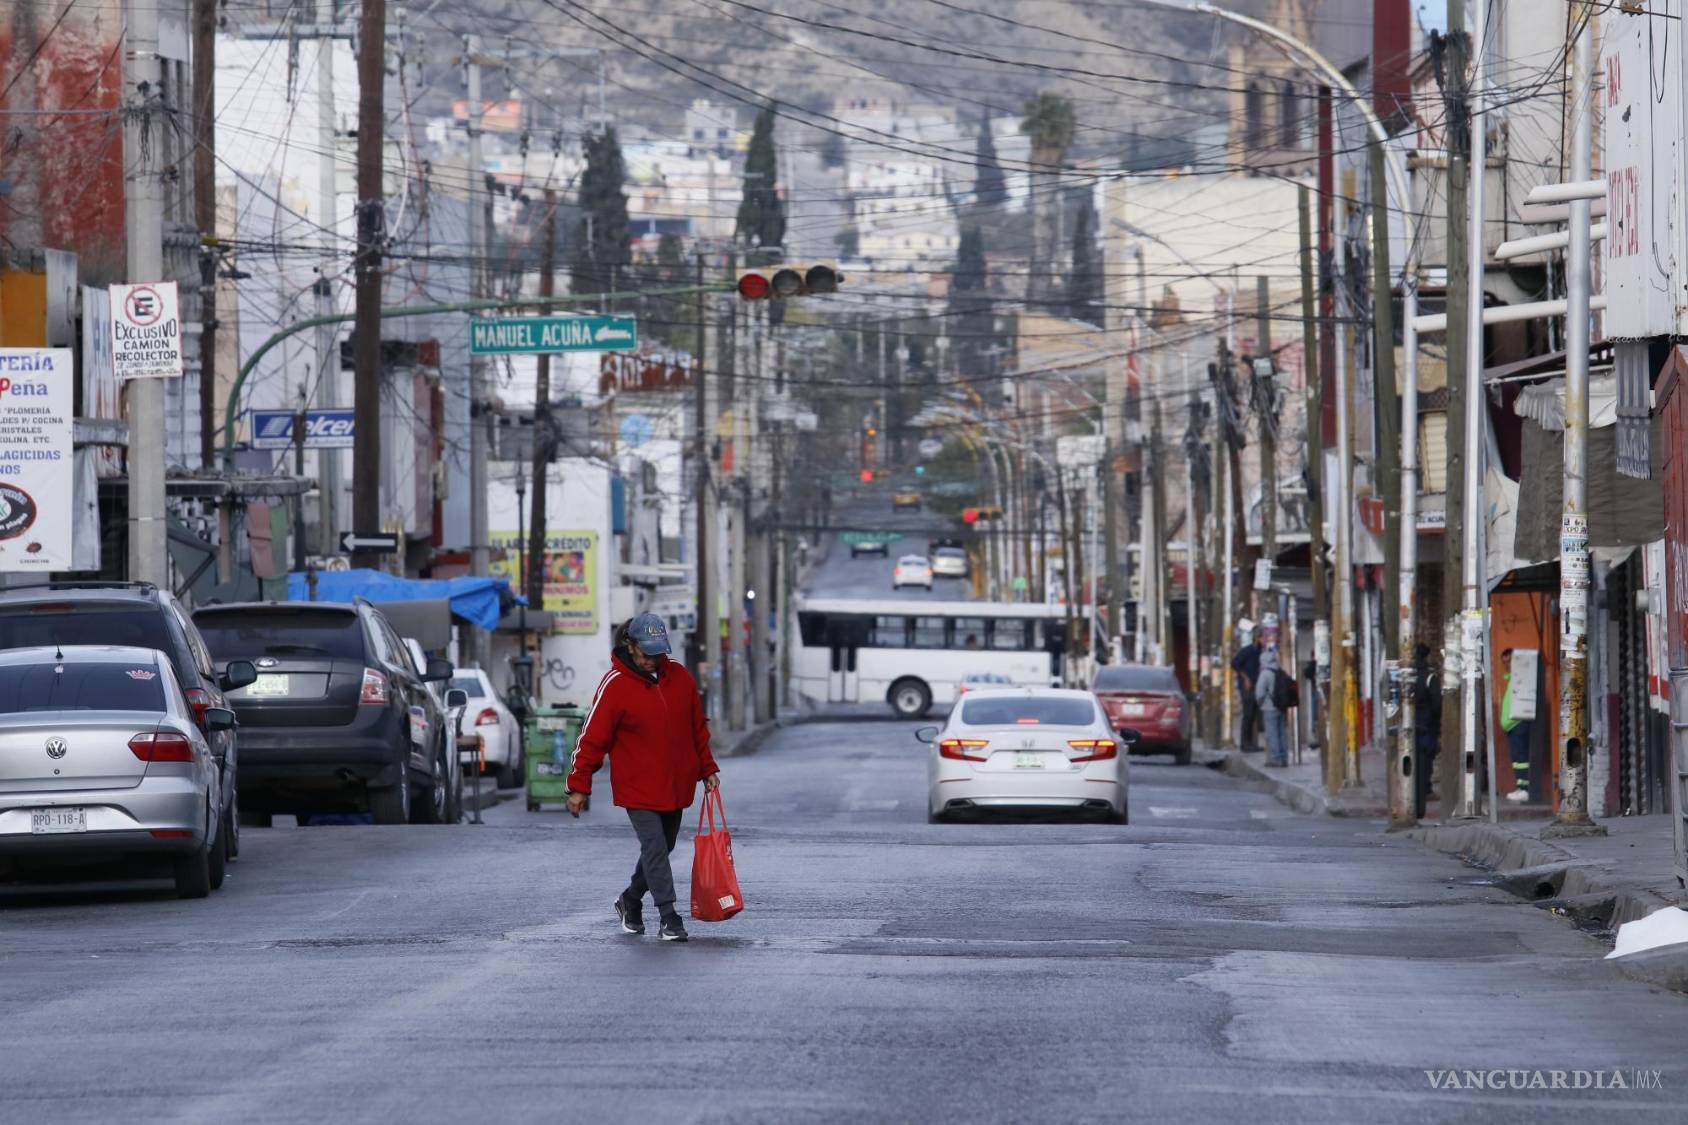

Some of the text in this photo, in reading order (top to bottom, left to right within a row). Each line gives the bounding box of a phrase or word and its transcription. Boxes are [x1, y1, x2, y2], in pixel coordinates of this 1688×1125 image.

[114, 318, 177, 340] EXCLUSIVO
[475, 320, 592, 348] MANUEL ACUÑA
[123, 339, 170, 350] CAMION
[115, 350, 178, 361] RECOLECTOR
